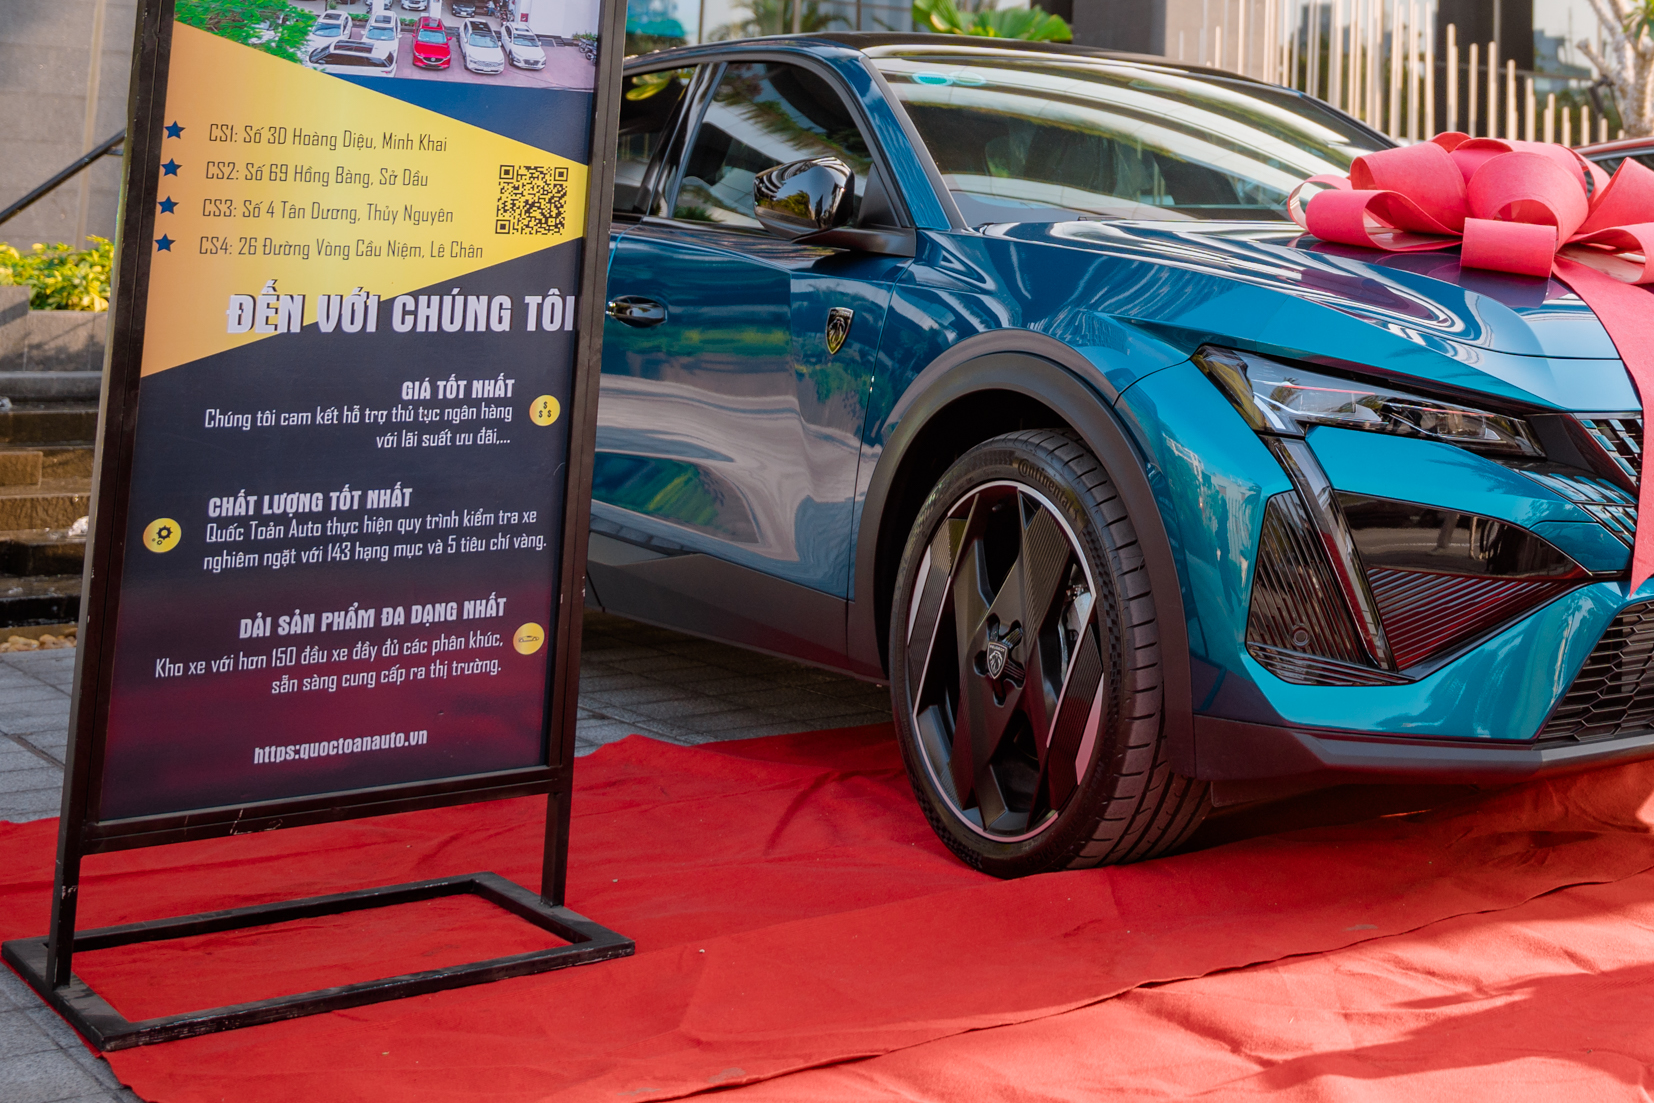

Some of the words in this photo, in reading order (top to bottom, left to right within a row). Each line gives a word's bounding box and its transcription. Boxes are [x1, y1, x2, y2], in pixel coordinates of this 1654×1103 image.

[209, 123, 238, 143] CS1:
[243, 125, 265, 144] Số
[293, 128, 337, 151] Hoàng
[343, 129, 377, 151] Diệu,
[382, 132, 414, 150] Minh
[419, 133, 447, 152] Khai
[206, 161, 240, 180] CS2:
[245, 162, 266, 182] Số
[269, 164, 289, 182] 69
[294, 165, 330, 187] Hồng
[335, 166, 374, 189] Bàng,
[380, 167, 398, 186] Sở
[402, 168, 428, 187] Dầu
[202, 198, 237, 218] CS3:
[242, 199, 264, 218] Số
[266, 201, 275, 219] 4
[281, 201, 306, 219] Tân
[311, 201, 361, 224] Dương,
[367, 203, 399, 225] Thủy
[403, 204, 454, 226] Nguyên
[199, 236, 233, 255] CS4:
[238, 236, 258, 256] 26
[262, 237, 310, 260] Đường
[316, 238, 350, 260] Vòng
[356, 239, 382, 257] Cầu
[387, 239, 425, 260] Niệm,
[430, 240, 445, 258] Lê
[450, 240, 483, 259] Chân
[226, 280, 304, 333] ĐẾN
[317, 288, 381, 333] VỚI
[392, 288, 512, 332] CHÚNG
[524, 289, 575, 331] TÔI
[402, 378, 431, 400] GIÁ
[437, 374, 467, 398] TỐT
[472, 373, 515, 398] NHẤT
[205, 407, 251, 430] Chúng
[256, 409, 276, 427] tôi
[281, 411, 312, 425] cam
[316, 406, 339, 425] kết
[343, 405, 360, 424] hỗ
[365, 407, 388, 426] trợ
[392, 404, 414, 422] thủ
[418, 407, 441, 425] tục
[444, 405, 477, 425] ngân
[481, 402, 513, 423] hàng
[376, 432, 398, 448] với
[401, 430, 418, 447] lãi
[422, 429, 451, 447] suất
[456, 432, 473, 445] ưu
[208, 489, 258, 517] CHẤT
[262, 491, 324, 518] LƯỢNG
[329, 484, 362, 511] TỐT
[366, 482, 413, 509] NHẤT
[1018, 458, 1075, 514] Continental
[206, 523, 244, 543] Quốc
[249, 520, 284, 540] Toản
[288, 519, 322, 538] Auto
[326, 517, 359, 537] thực
[363, 515, 393, 534] hiện
[397, 517, 422, 534] quy
[426, 510, 459, 529] trình
[463, 508, 494, 527] kiểm
[498, 510, 518, 524] tra
[522, 511, 537, 523] xe
[203, 550, 259, 573] nghiêm
[263, 548, 296, 569] ngặt
[301, 546, 323, 563] với
[327, 542, 351, 562] 143
[355, 541, 389, 562] hạng
[393, 543, 423, 558] mục
[428, 539, 443, 555] và
[448, 535, 456, 554] 5
[460, 537, 485, 553] tiêu
[490, 532, 510, 550] chí
[513, 533, 547, 550] vàng.
[239, 611, 272, 639] DẢI
[277, 609, 315, 636] SẢN
[321, 602, 375, 632] PHẨM
[381, 606, 405, 627] ĐA
[410, 601, 458, 627] DẠNG
[463, 592, 507, 620] NHẤT
[155, 658, 183, 678] Kho
[188, 660, 206, 675] xe
[211, 654, 234, 673] với
[239, 651, 267, 670] hơn
[272, 647, 297, 667] 150
[301, 646, 327, 665] đầu
[331, 648, 348, 662] xe
[352, 641, 378, 661] đầy
[382, 638, 399, 657] đủ
[403, 638, 428, 655] các
[431, 633, 465, 656] phân
[469, 630, 503, 649] khúc,
[272, 675, 298, 694] sẵn
[302, 674, 337, 692] sàng
[342, 671, 376, 688] cung
[380, 664, 406, 685] cấp
[410, 666, 426, 680] ra
[430, 660, 449, 679] thị
[452, 658, 501, 676] trường.
[254, 730, 428, 764] https:quoctoanauto.vn
